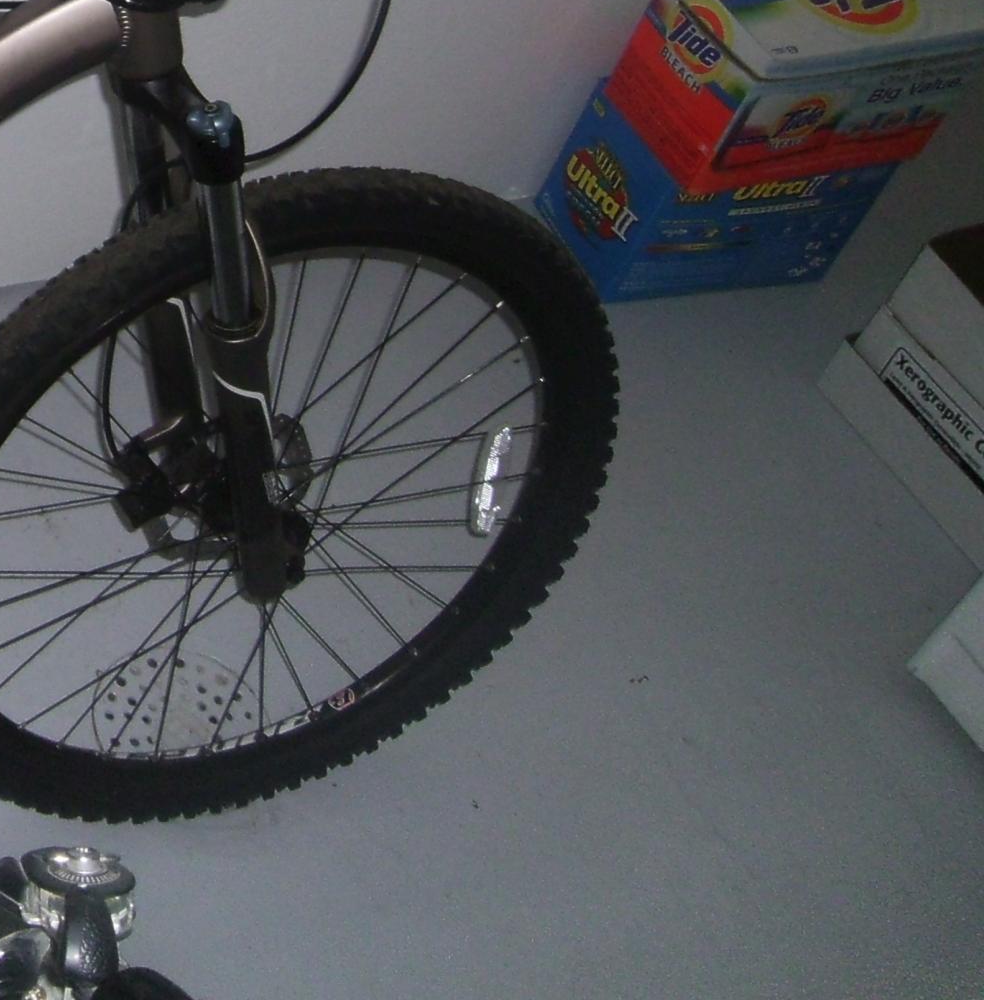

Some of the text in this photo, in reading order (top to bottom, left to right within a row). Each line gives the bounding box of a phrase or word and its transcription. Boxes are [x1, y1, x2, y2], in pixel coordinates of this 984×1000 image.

[666, 9, 722, 67] Tide
[660, 46, 701, 93] BLEACH
[566, 153, 621, 220] Ultra
[732, 179, 804, 201] Ultra
[895, 352, 974, 441] Xerographic
